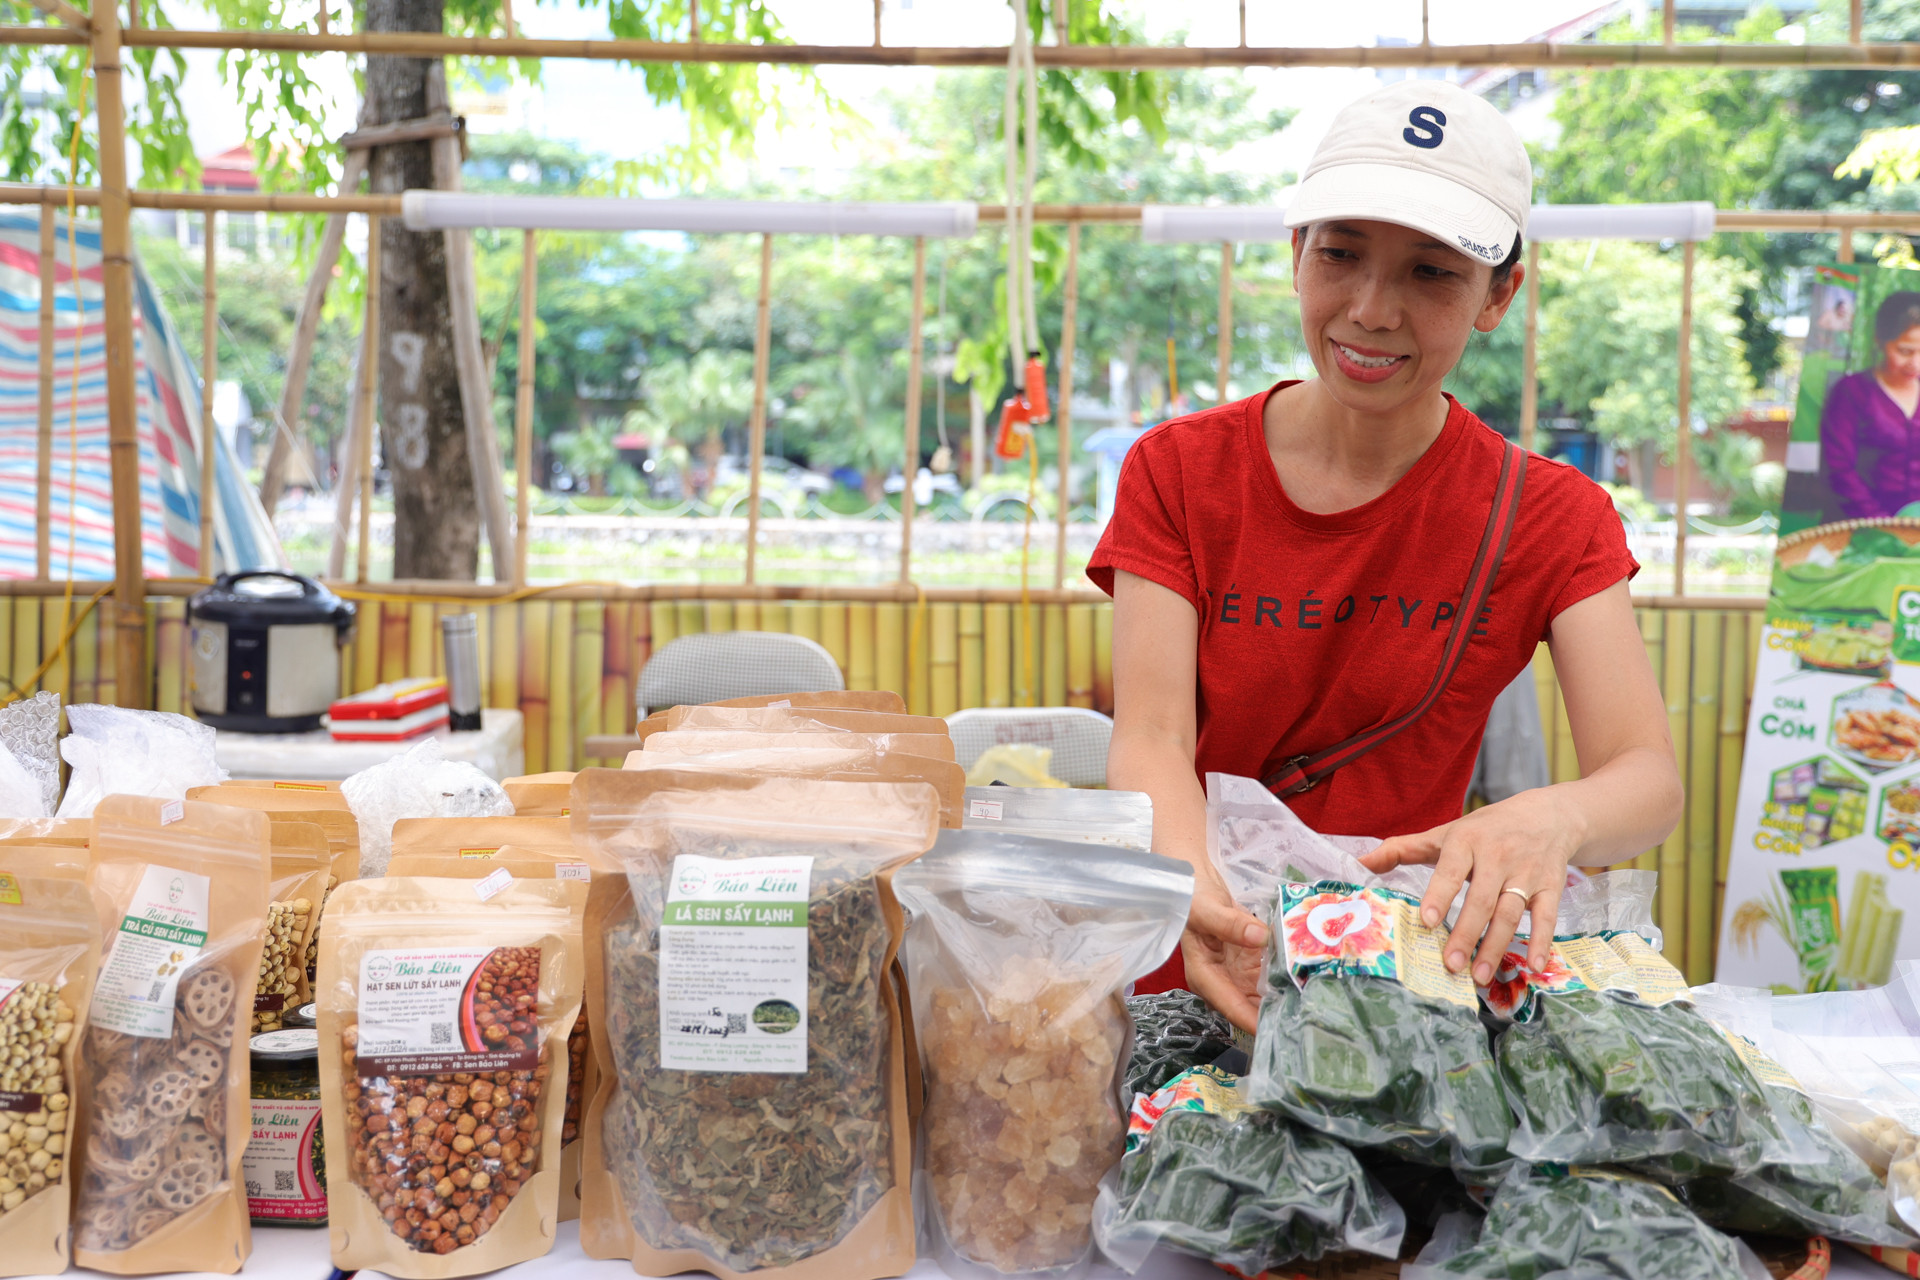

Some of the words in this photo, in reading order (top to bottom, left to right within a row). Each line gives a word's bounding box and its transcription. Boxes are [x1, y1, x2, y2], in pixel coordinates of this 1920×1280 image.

[1403, 106, 1446, 149] S
[1458, 235, 1490, 259] SHARE
[1206, 583, 1492, 636] ÉRÉOTYPE
[755, 876, 798, 892] Liên
[675, 904, 693, 921] LÁ
[696, 907, 721, 921] SEN
[724, 903, 752, 922] SẤY
[755, 908, 794, 926] LẠNH
[125, 919, 141, 932] TRÀ
[142, 922, 154, 935] CỦ
[154, 926, 168, 938] SEN
[168, 927, 184, 941] SẤY
[183, 932, 204, 946] LẠNH
[394, 960, 424, 976] Bảo
[427, 959, 463, 975] Liên
[367, 982, 383, 994] HẠT
[385, 981, 402, 991] SEN
[421, 977, 437, 989] SẤY
[439, 979, 461, 990] LẠNH
[464, 1060, 478, 1068] Sen
[494, 1059, 508, 1067] Liên
[252, 1111, 266, 1125] ảo
[268, 1112, 300, 1126] Liên
[253, 1128, 270, 1139] SẤY
[273, 1131, 298, 1141] LẠNH
